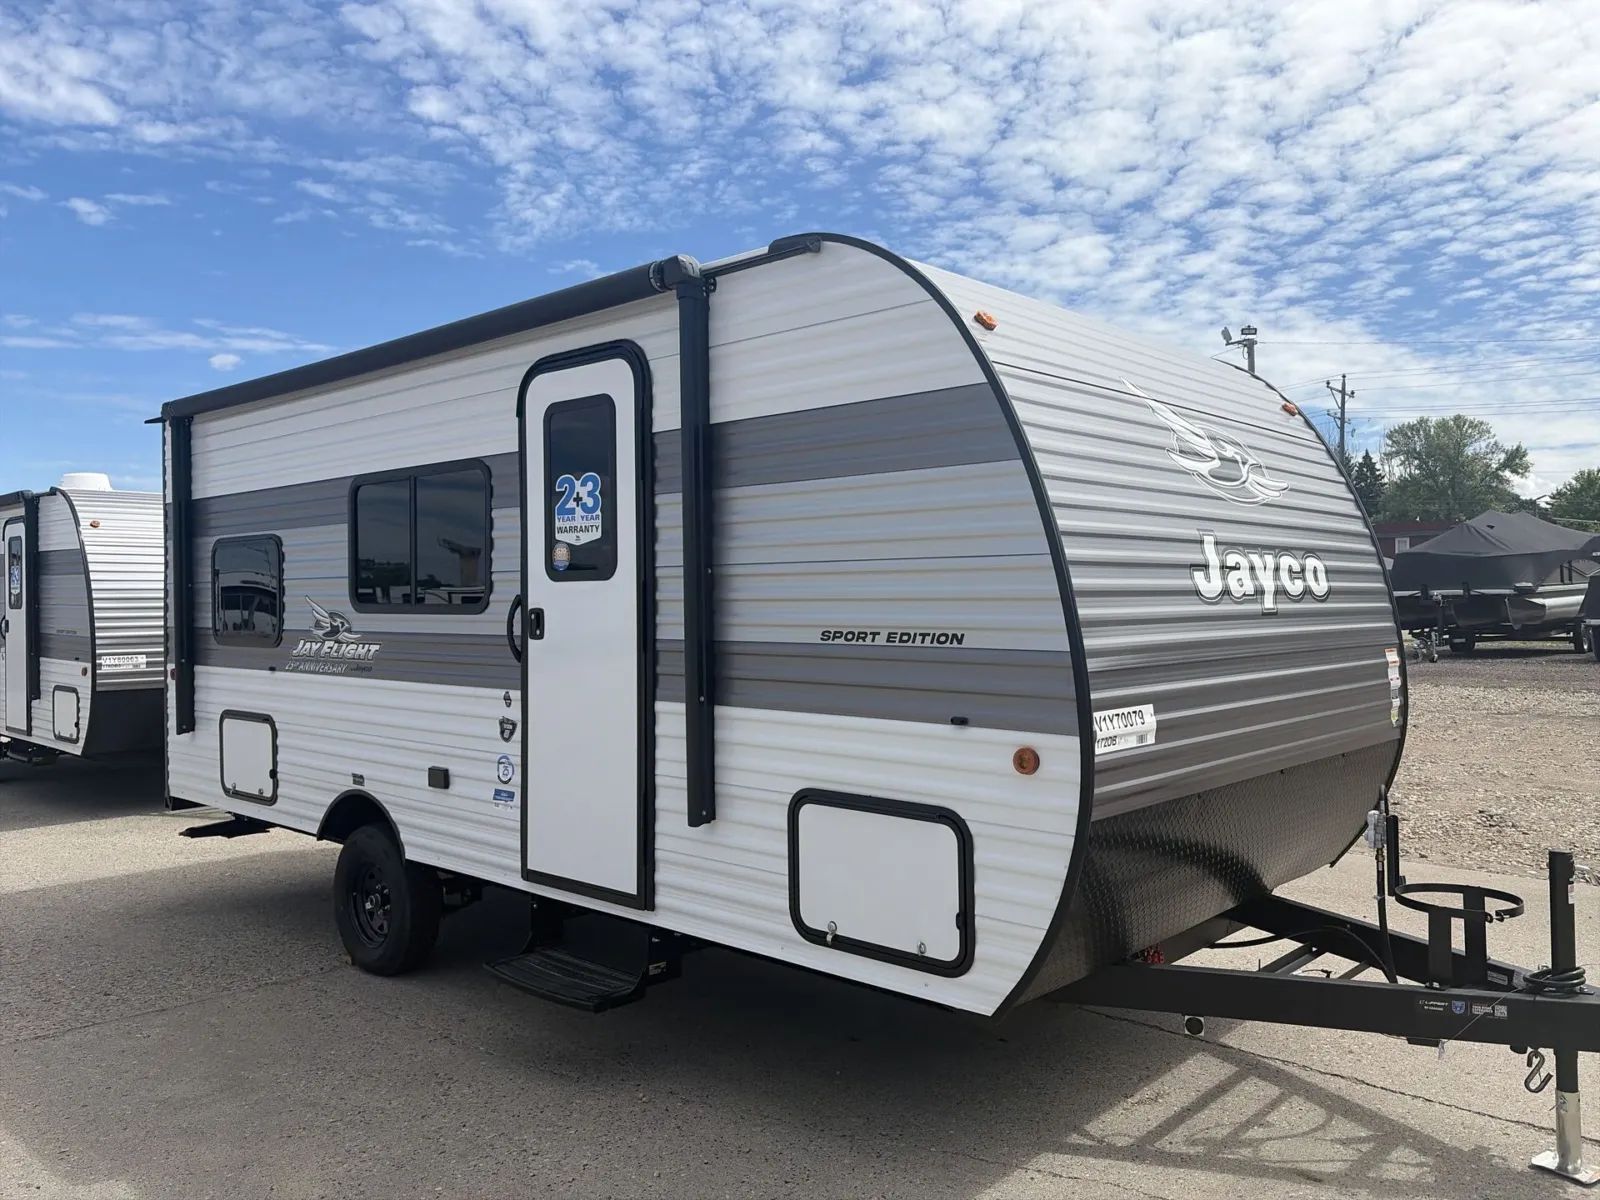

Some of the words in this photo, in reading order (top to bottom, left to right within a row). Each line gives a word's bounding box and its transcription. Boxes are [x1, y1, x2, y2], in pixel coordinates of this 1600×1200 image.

[557, 514, 576, 523] YEAR
[580, 514, 600, 522] YEAR
[556, 524, 600, 535] WARRANTY
[1190, 529, 1331, 615] Jayco
[820, 630, 881, 643] SPORT
[886, 632, 965, 645] EDITION
[292, 639, 322, 659] JAY
[320, 639, 382, 662] FLIGHT
[298, 660, 348, 674] ANNIVERSARY
[1094, 709, 1146, 732] V1Y70079
